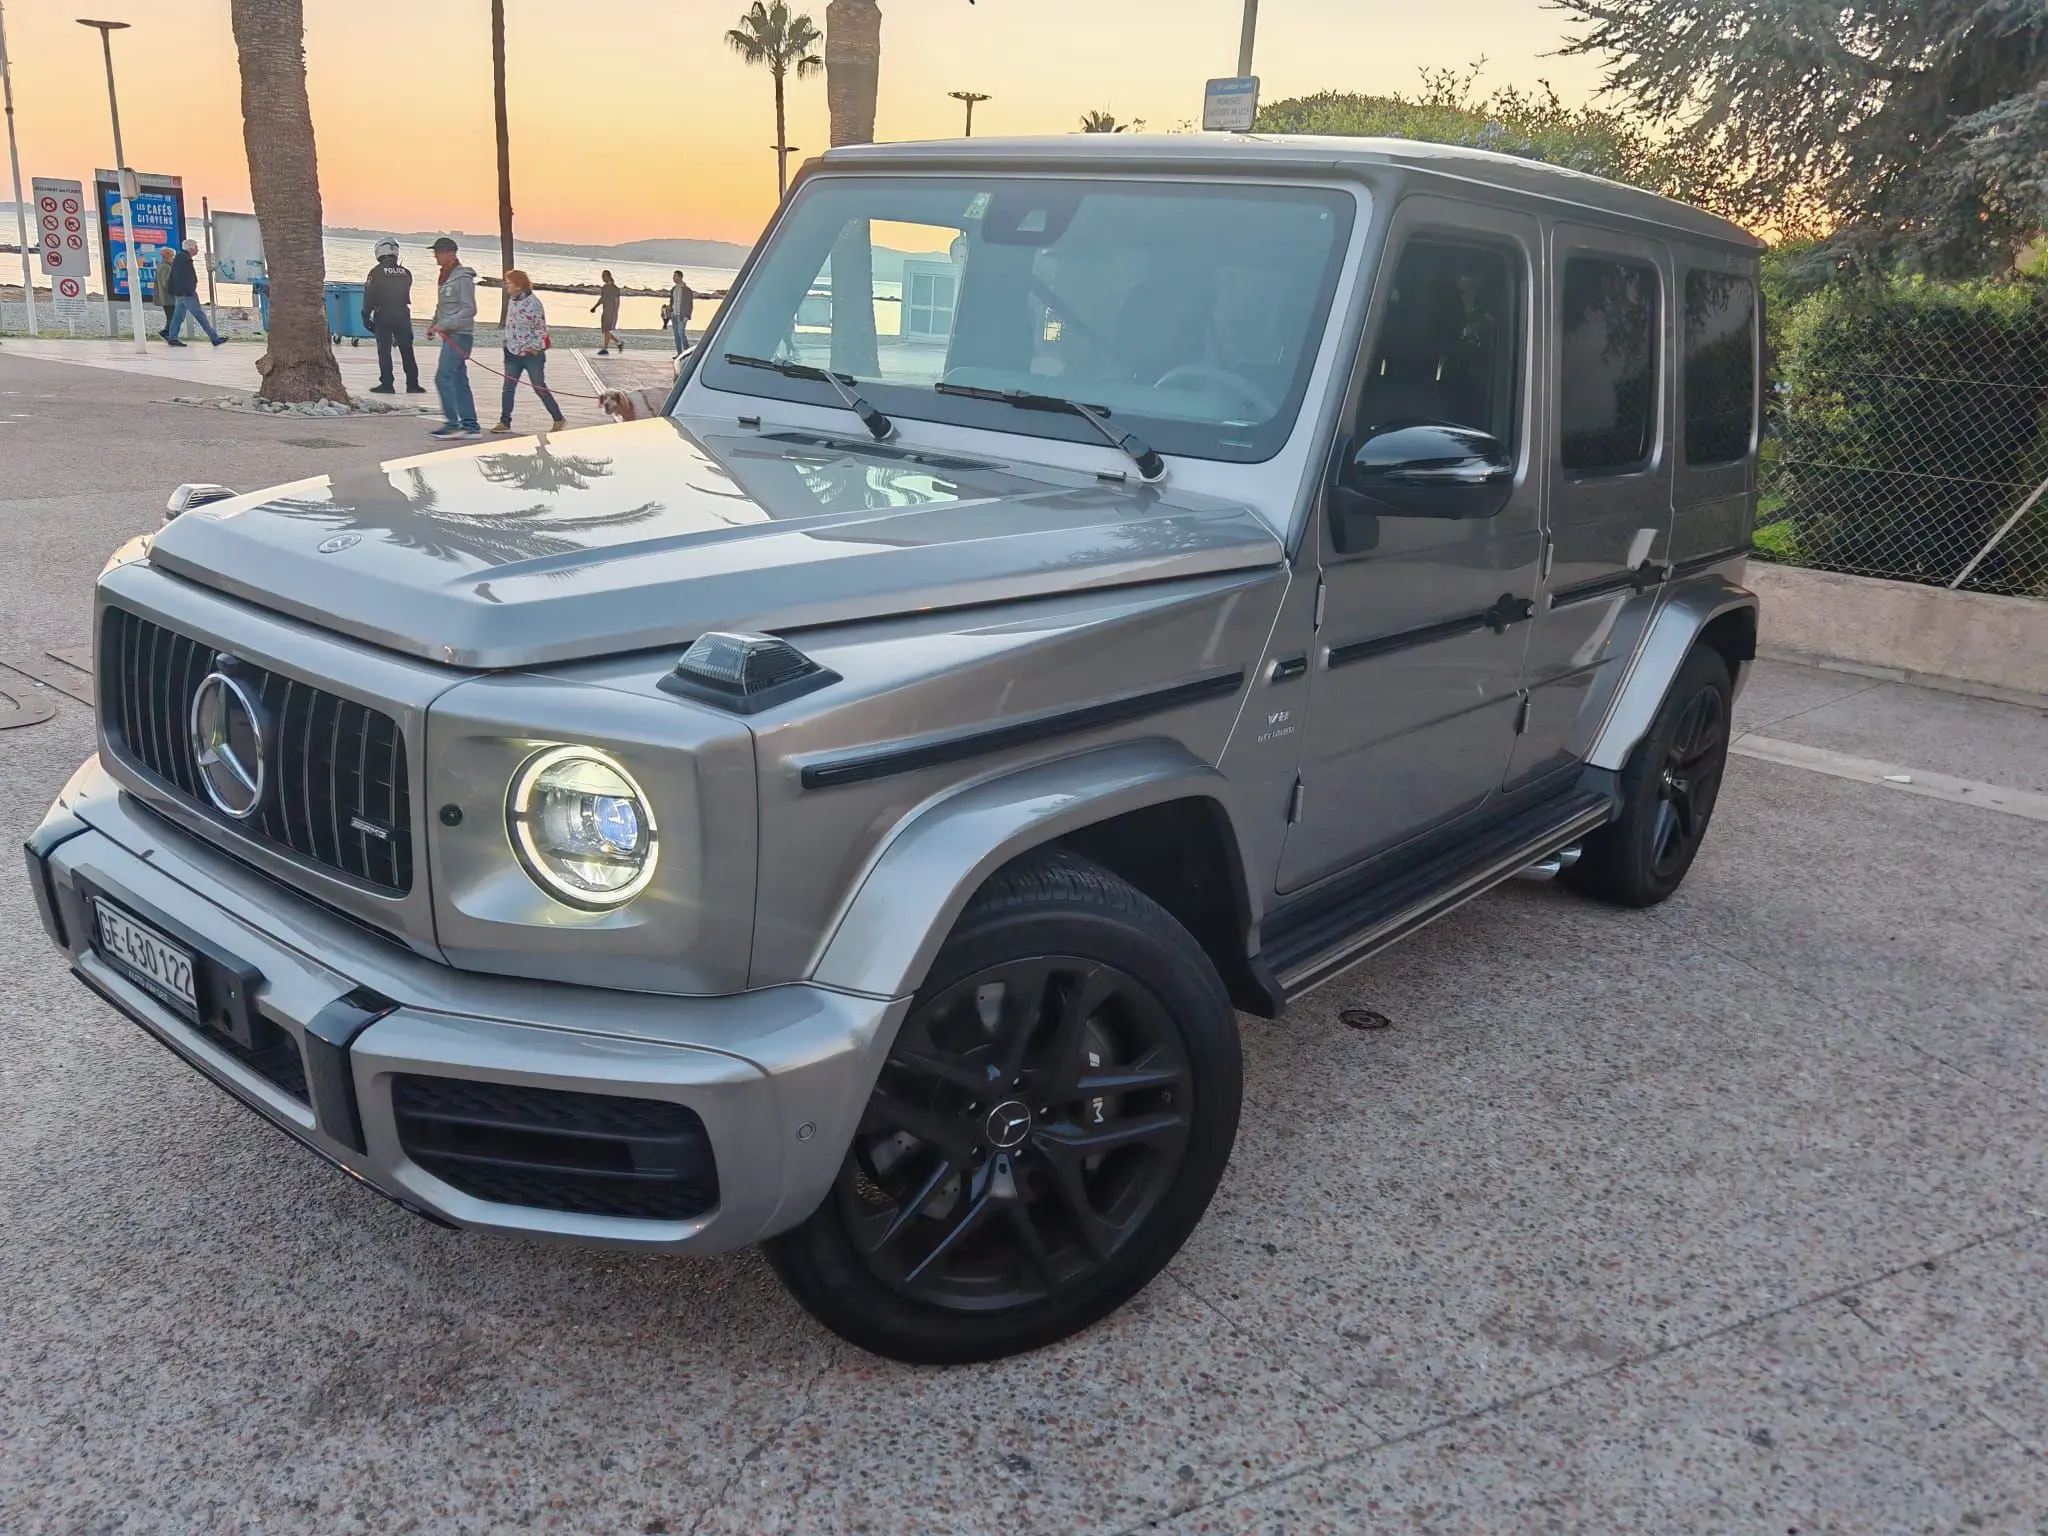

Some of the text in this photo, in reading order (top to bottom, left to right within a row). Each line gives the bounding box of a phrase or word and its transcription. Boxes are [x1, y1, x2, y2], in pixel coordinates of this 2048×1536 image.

[147, 203, 173, 216] CAFÉS
[137, 214, 173, 225] CITOYENS
[1267, 711, 1290, 725] V8
[360, 822, 387, 840] AMG
